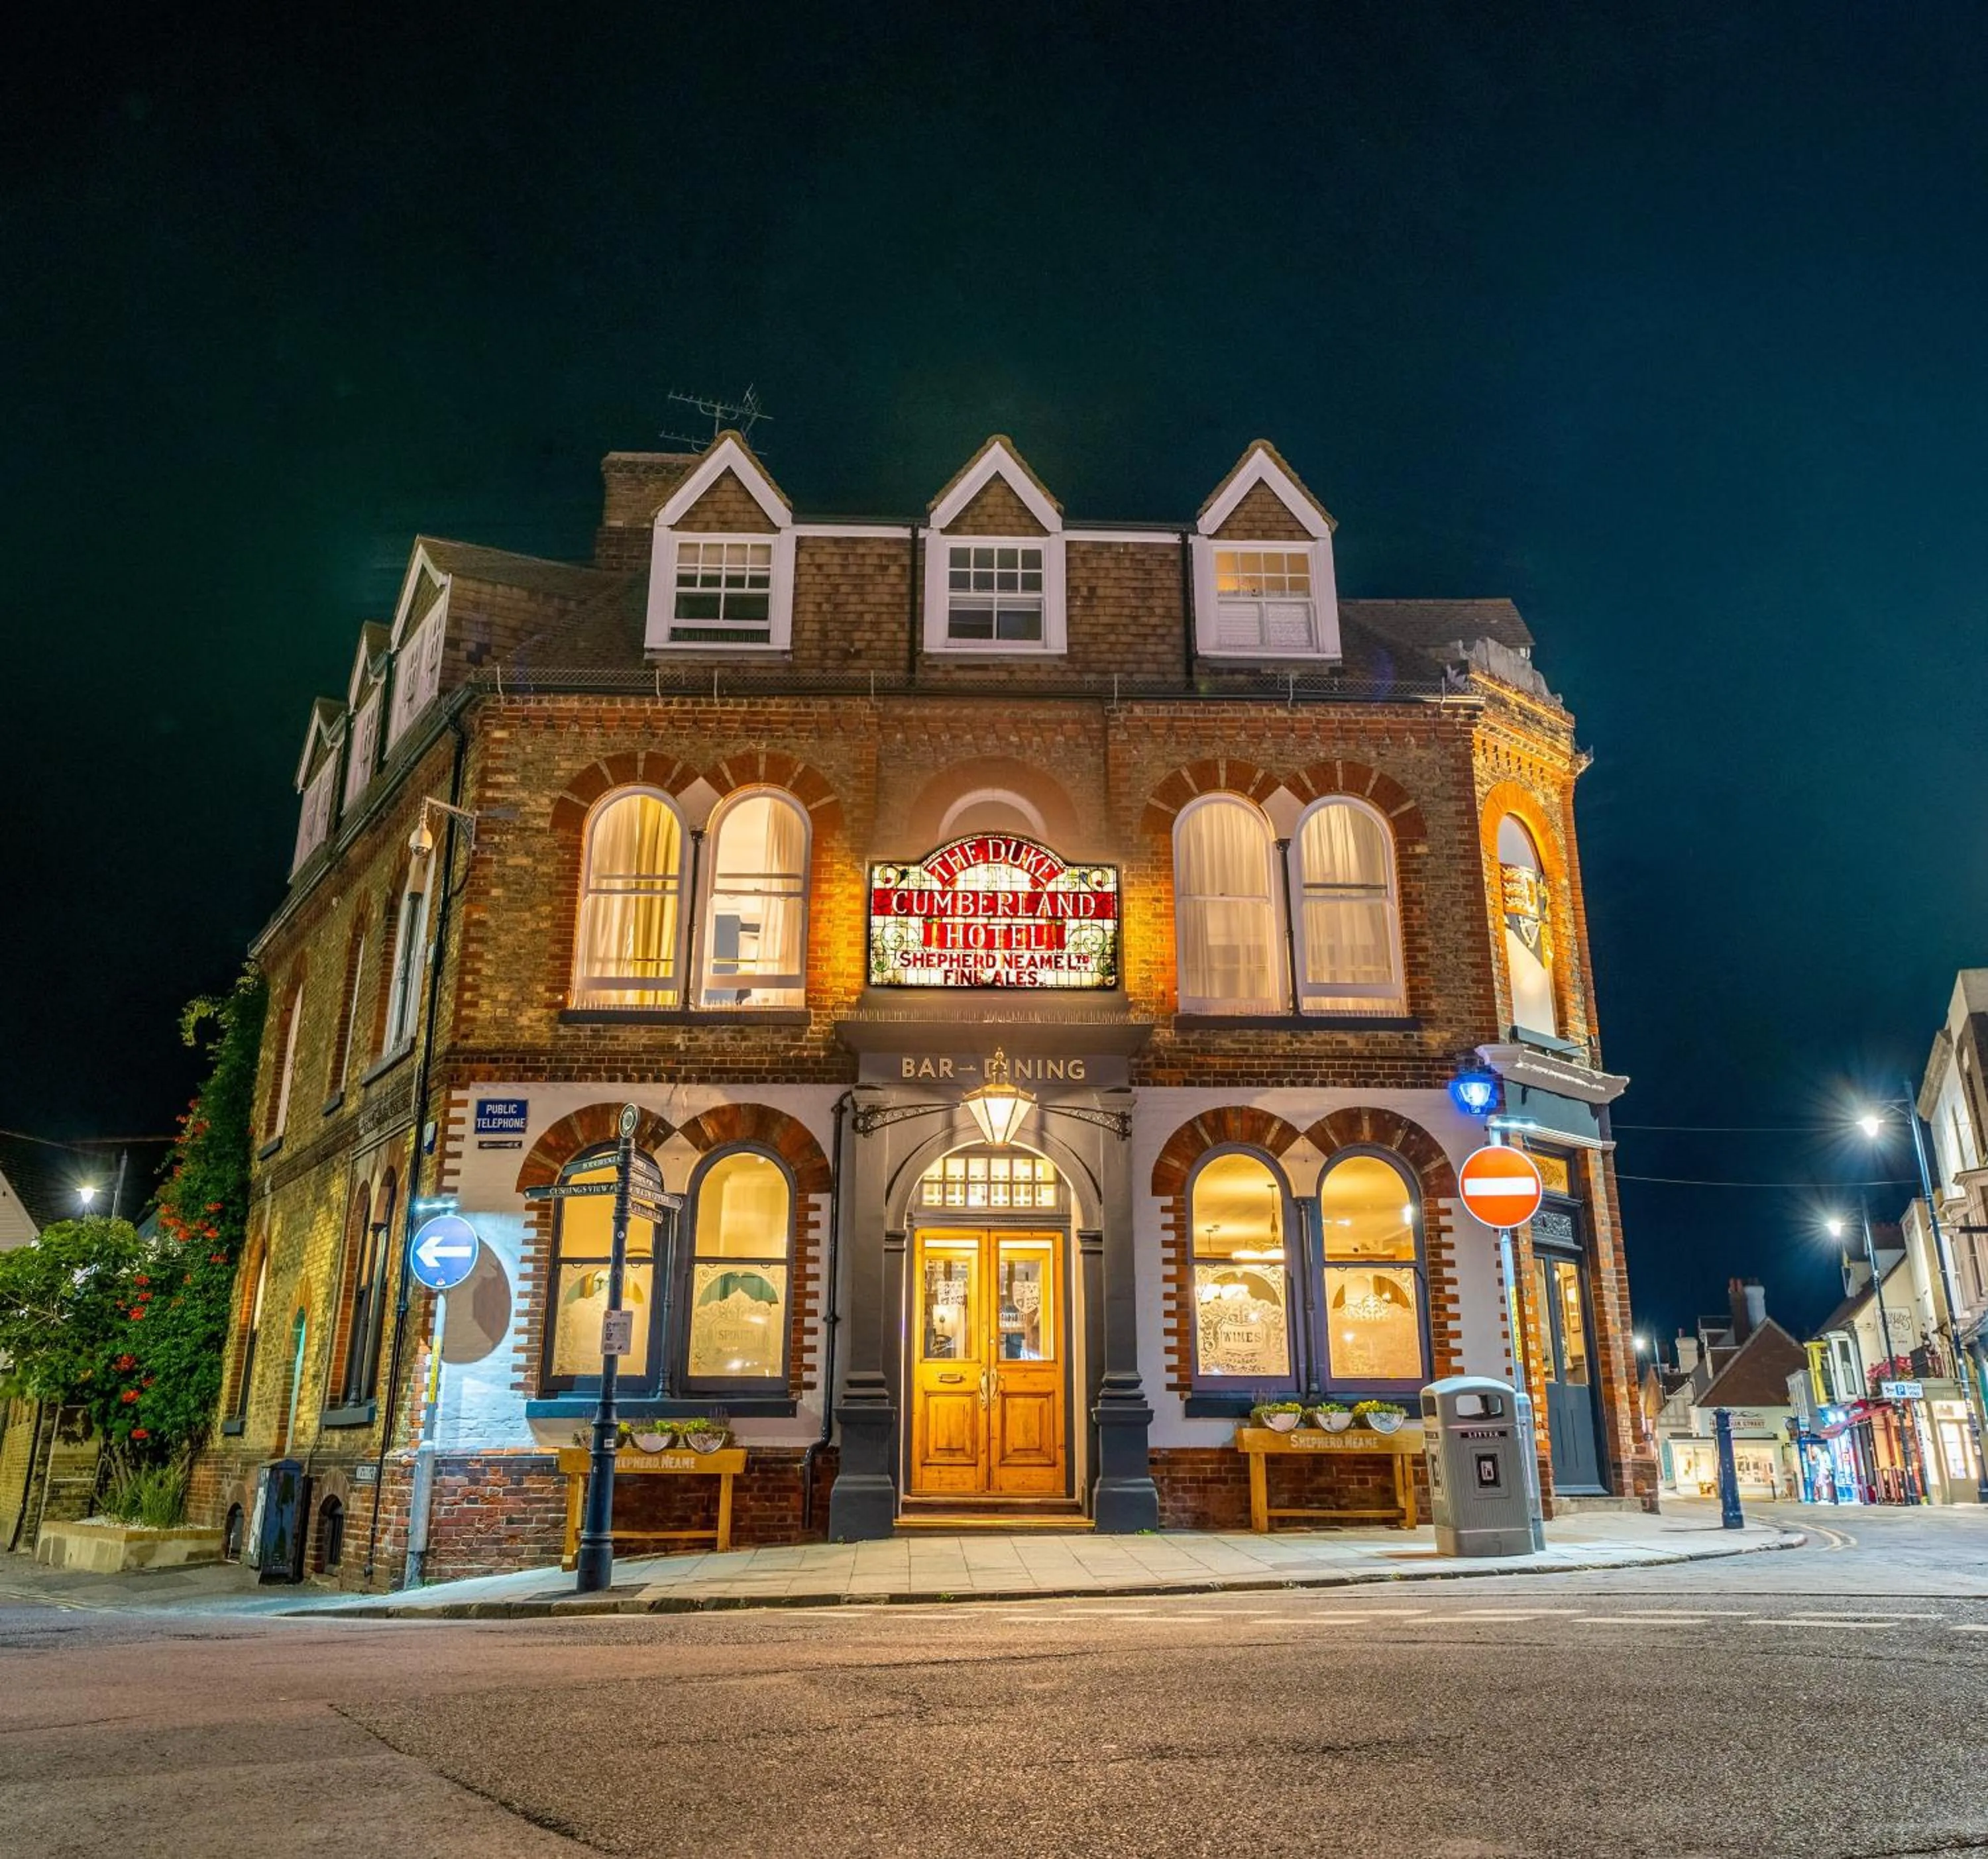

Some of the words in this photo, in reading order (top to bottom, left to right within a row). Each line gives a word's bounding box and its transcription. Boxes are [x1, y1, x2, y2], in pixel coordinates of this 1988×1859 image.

[928, 839, 983, 881] THE
[987, 838, 1058, 887] DUKE
[891, 890, 1096, 918] CUMBERLAND
[945, 924, 1044, 950] HOTEL
[899, 951, 996, 969] SHEPHERD
[1002, 953, 1066, 969] NEAME
[901, 1057, 955, 1079] BAR
[486, 1104, 518, 1114] PUBLIC
[477, 1118, 525, 1128] TELEPHONE
[1222, 1331, 1262, 1343] WINES
